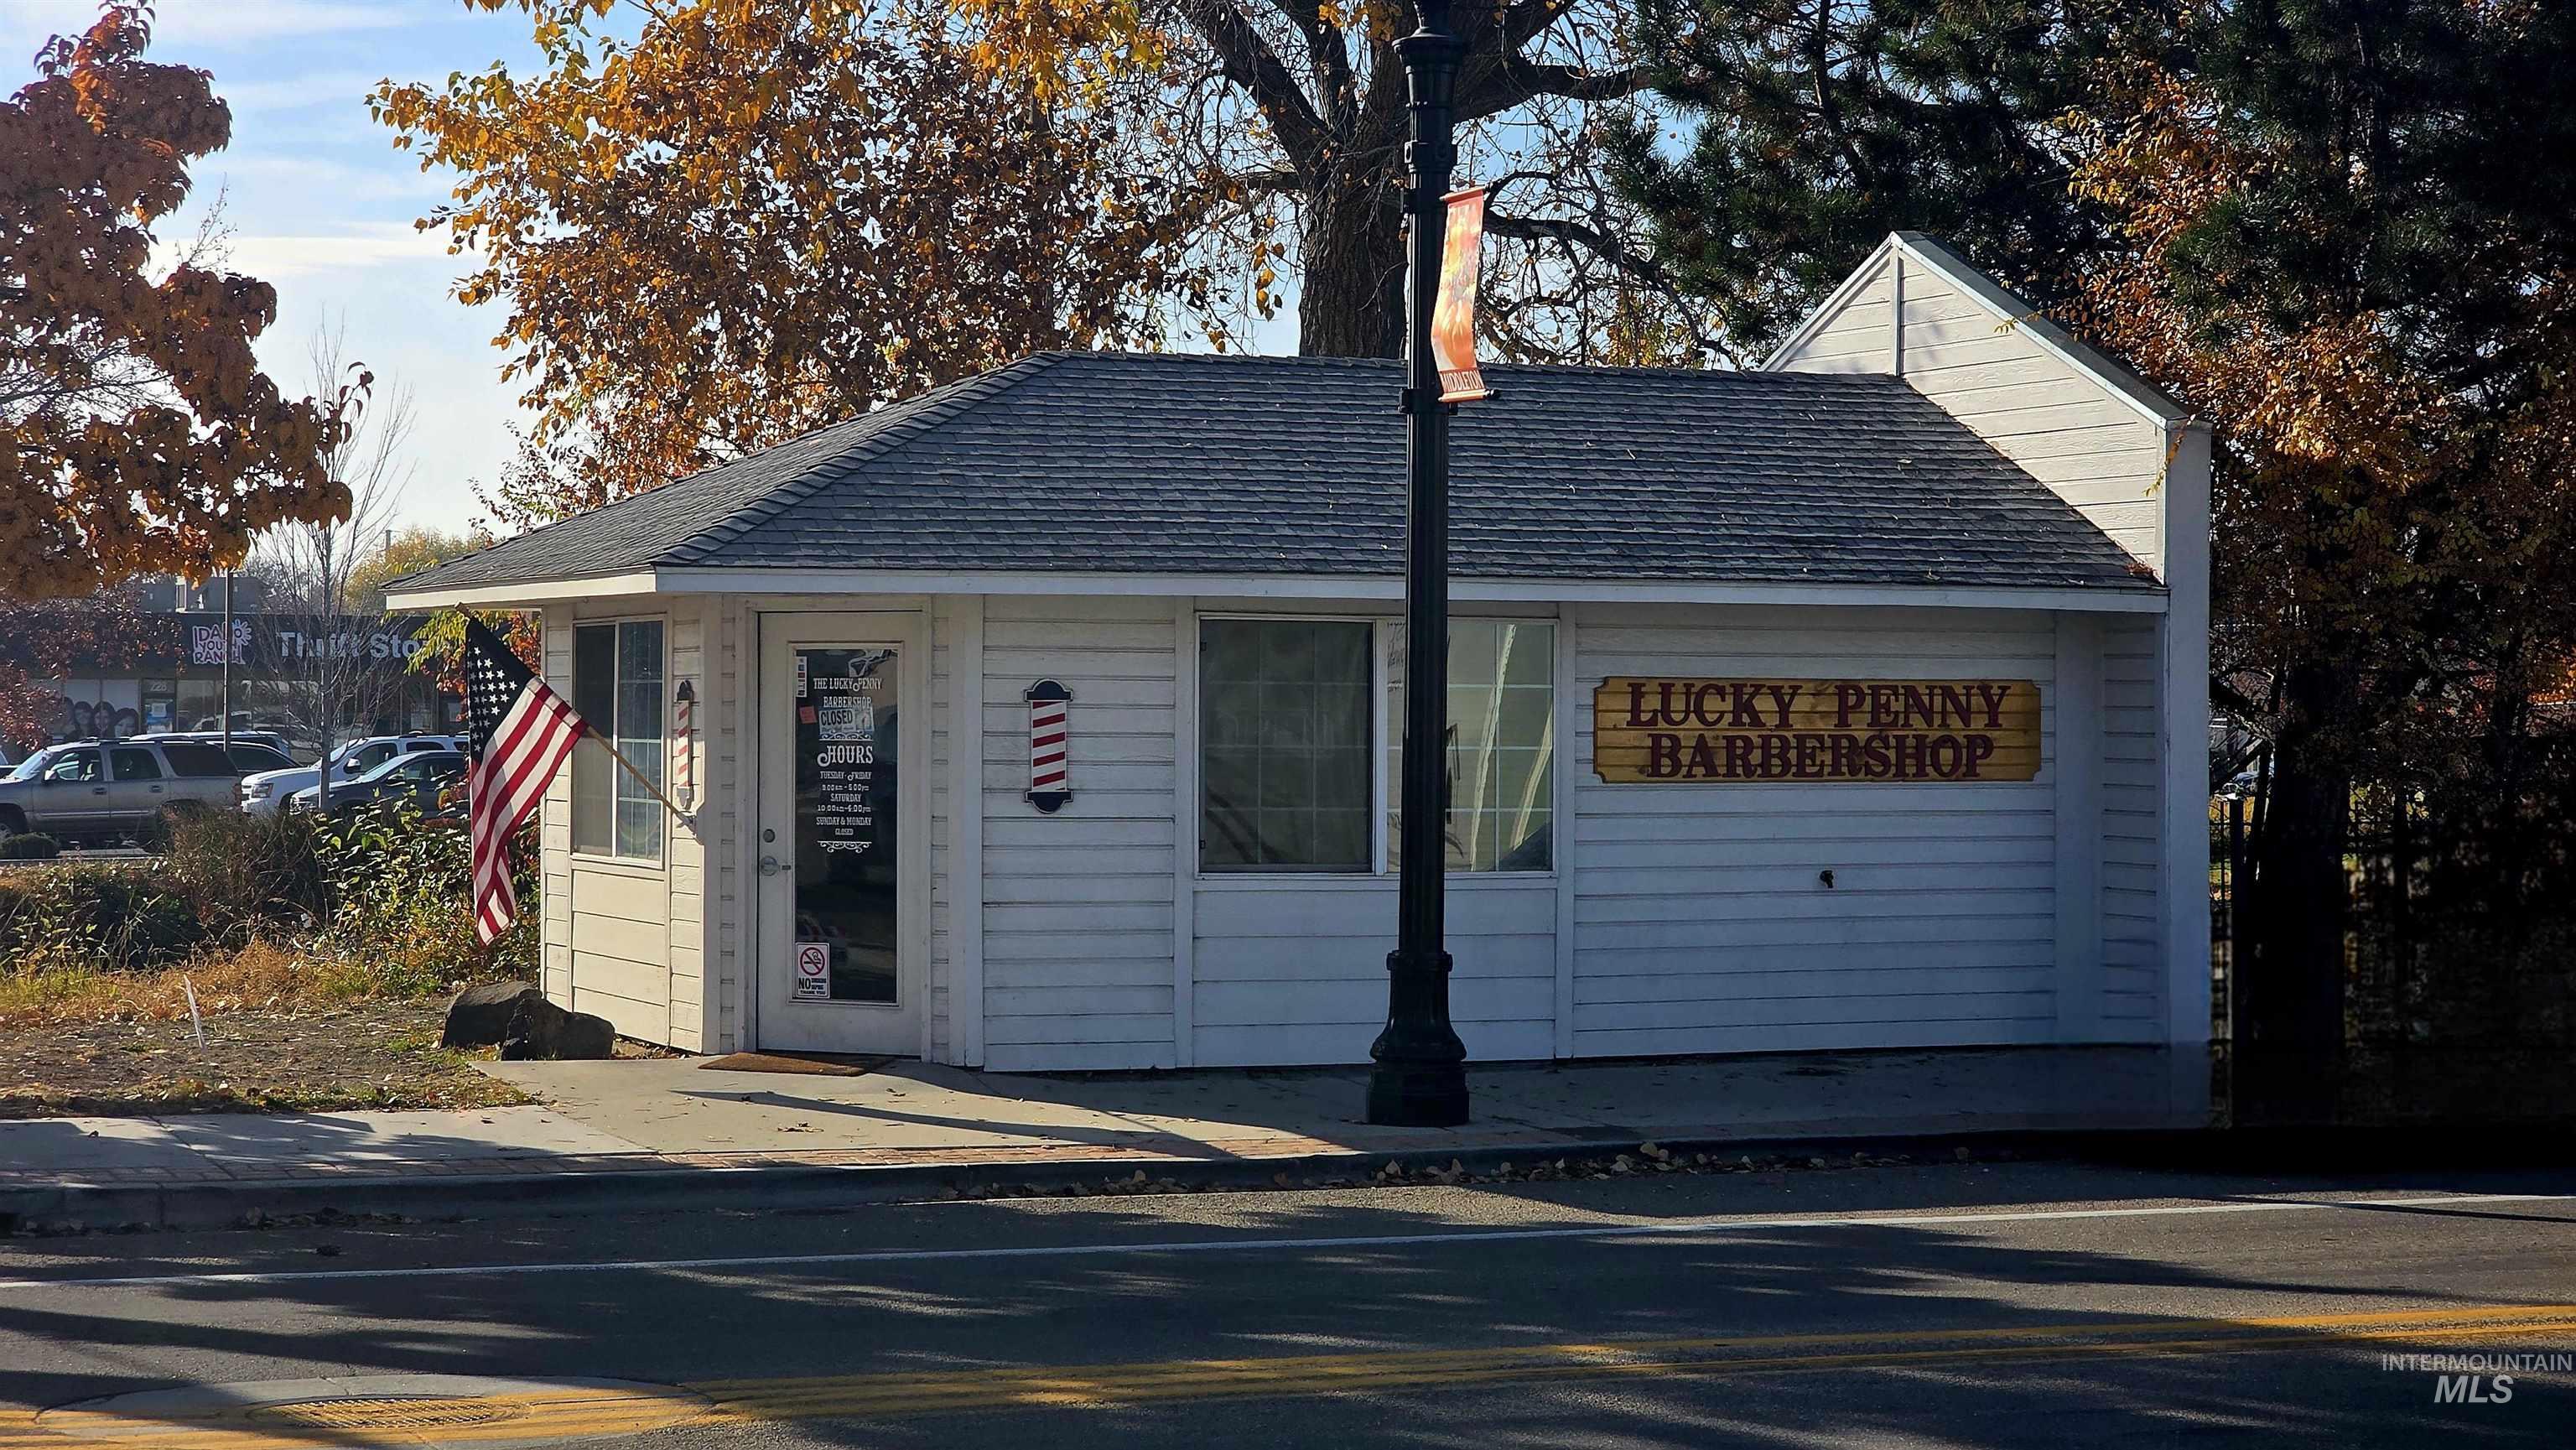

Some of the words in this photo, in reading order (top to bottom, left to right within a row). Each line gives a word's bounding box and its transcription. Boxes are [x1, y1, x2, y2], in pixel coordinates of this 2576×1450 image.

[1440, 370, 1484, 392] MIDDLETON
[199, 640, 240, 653] YOUH
[370, 632, 445, 658] Sto
[195, 651, 241, 663] RANH
[813, 678, 828, 689] THE
[829, 678, 853, 689] LUCKY
[853, 678, 882, 691] PENNY
[823, 696, 872, 709] BARBERSHOP
[1626, 683, 1800, 728] LUCKY
[1834, 683, 2011, 728] PENNY
[821, 710, 853, 725] CLOSED
[818, 746, 873, 767] HOURS
[1647, 733, 1994, 778] BARBERSHOP
[830, 793, 862, 802] SATURDAY
[798, 977, 811, 990] NO
